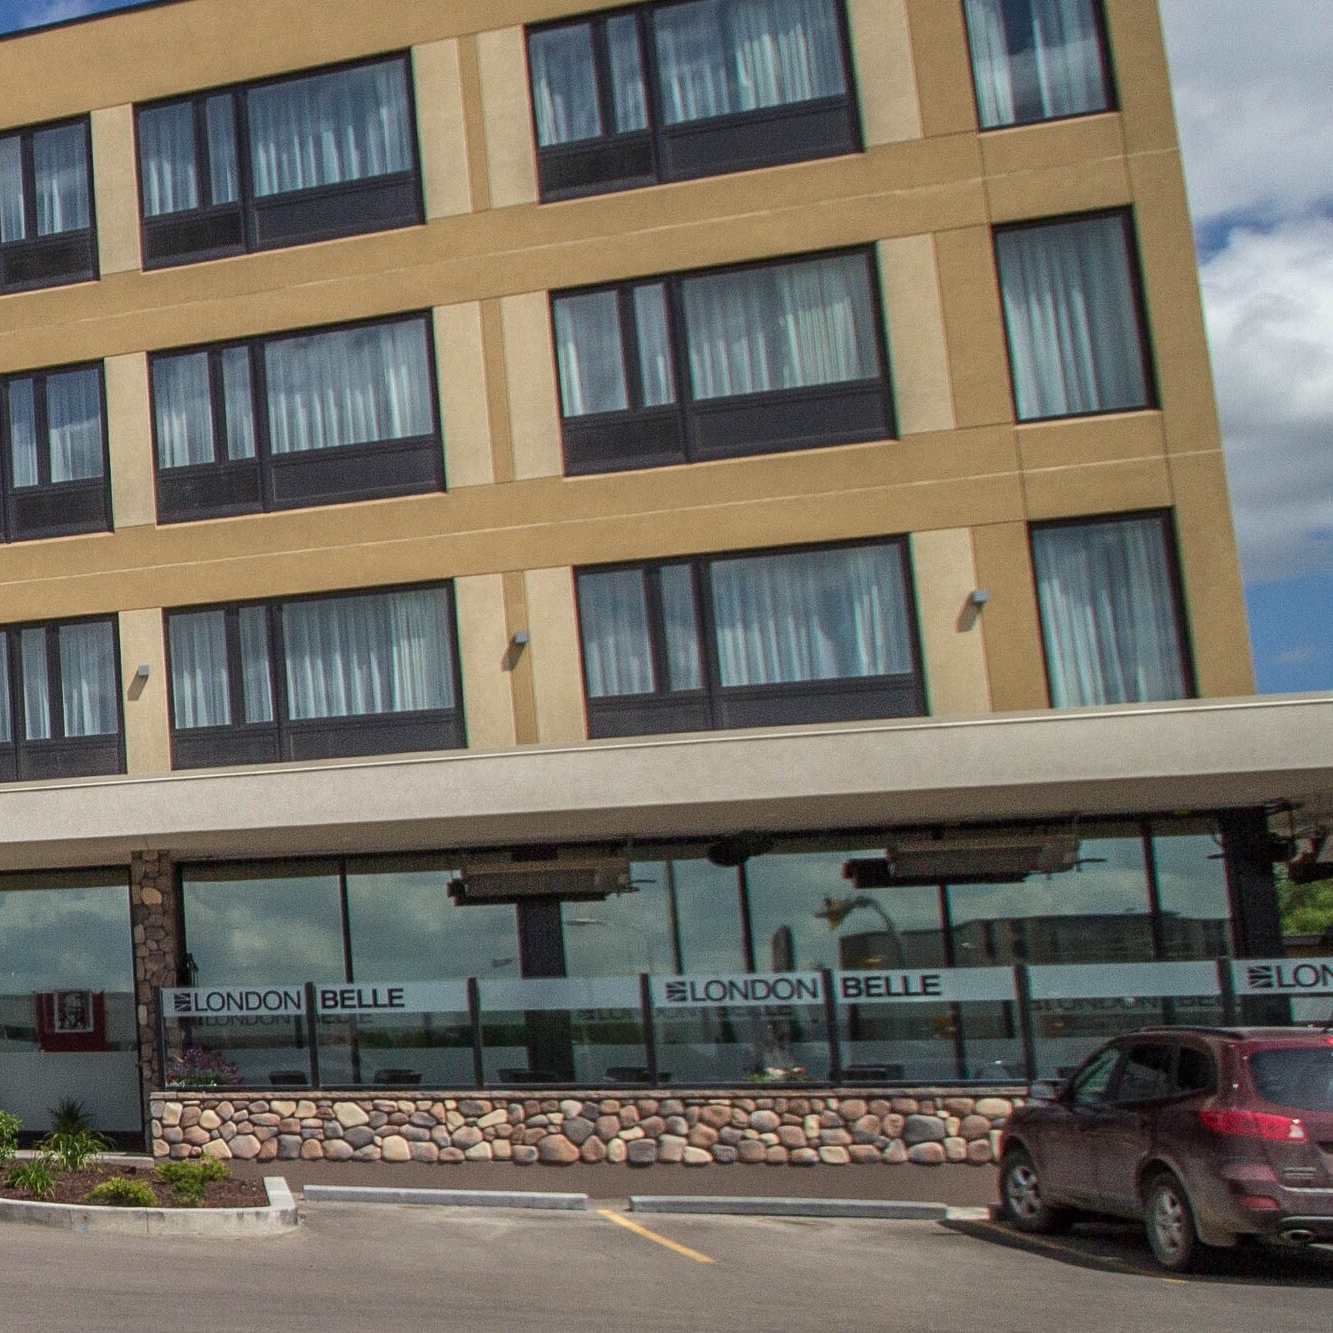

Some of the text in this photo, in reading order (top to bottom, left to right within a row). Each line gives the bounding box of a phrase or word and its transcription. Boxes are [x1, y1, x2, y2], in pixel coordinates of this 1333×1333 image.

[194, 987, 405, 1013] LONDON BELLE
[689, 974, 942, 1002] LONDON BELLE
